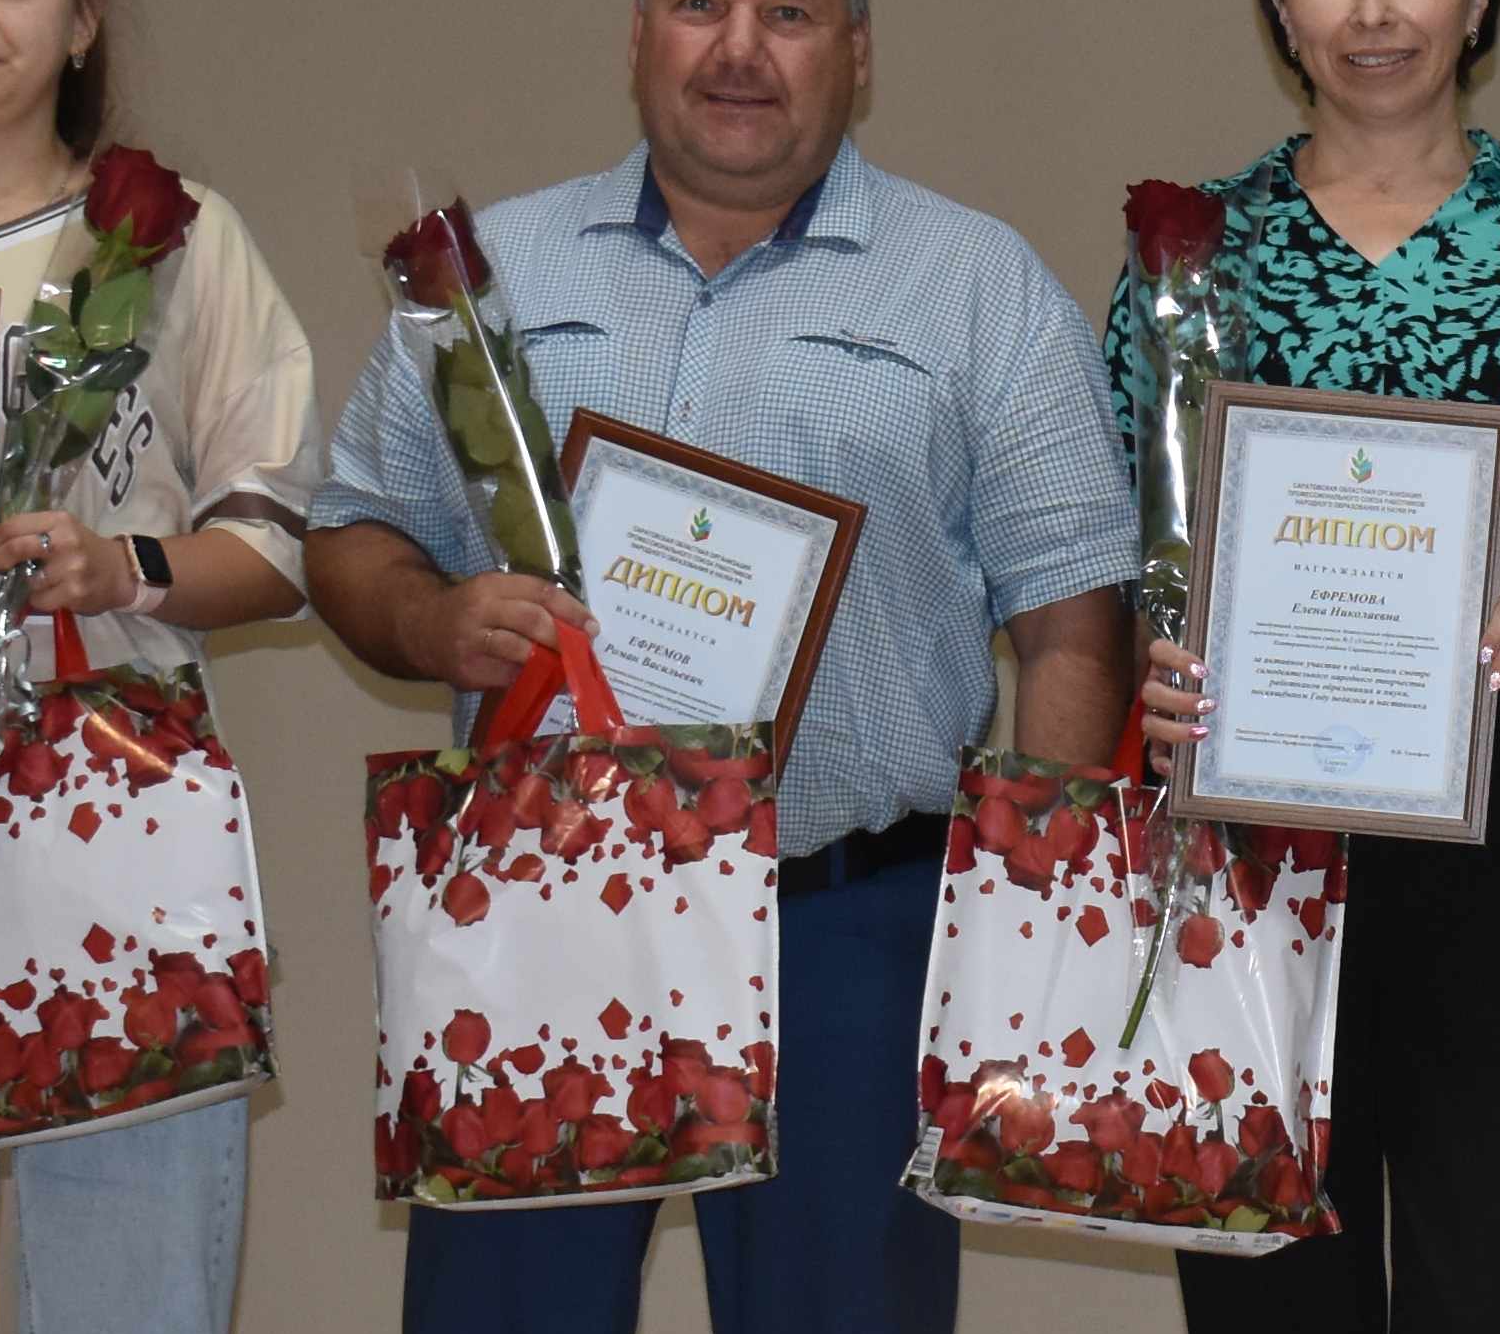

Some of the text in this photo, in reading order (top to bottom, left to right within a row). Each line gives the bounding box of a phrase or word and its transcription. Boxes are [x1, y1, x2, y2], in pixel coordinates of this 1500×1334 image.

[1273, 513, 1436, 557] ДИПЛОМ
[1293, 563, 1403, 580] НАГРАЖДАЕТСЯ
[603, 554, 756, 628] ДИПЛОМ
[1310, 589, 1385, 605] ЕФРЕМОВА
[1291, 602, 1400, 622] Елена Николаевна
[603, 642, 704, 685] Роман Васильевич
[628, 635, 691, 665] ЕФРЕМОВ
